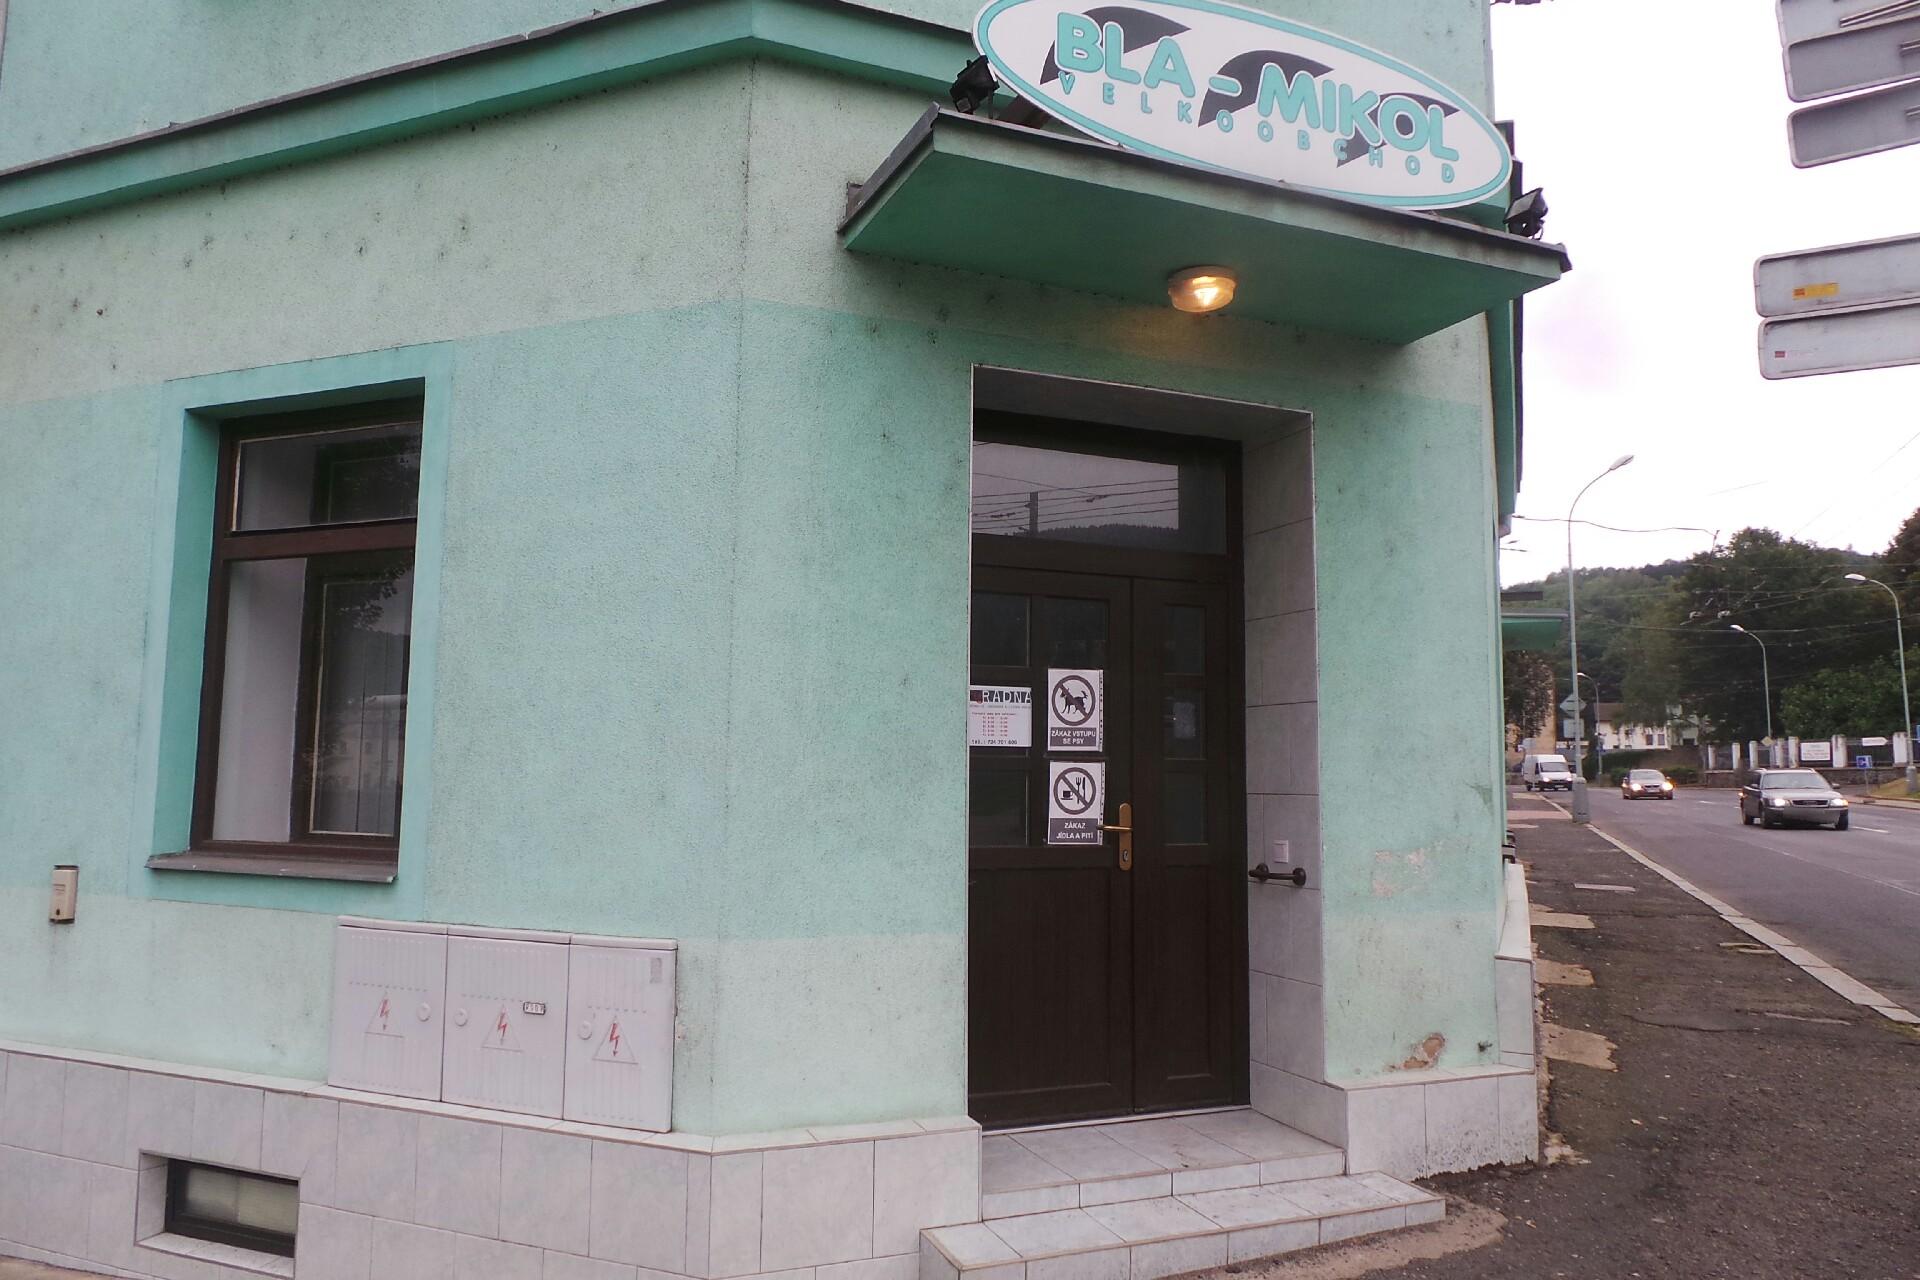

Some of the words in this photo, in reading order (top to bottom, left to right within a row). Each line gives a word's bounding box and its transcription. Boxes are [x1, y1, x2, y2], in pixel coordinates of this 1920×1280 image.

[1055, 11, 1197, 98] BLA
[1256, 63, 1460, 162] MIKOL
[1058, 71, 1455, 184] VELKOOBCHOD
